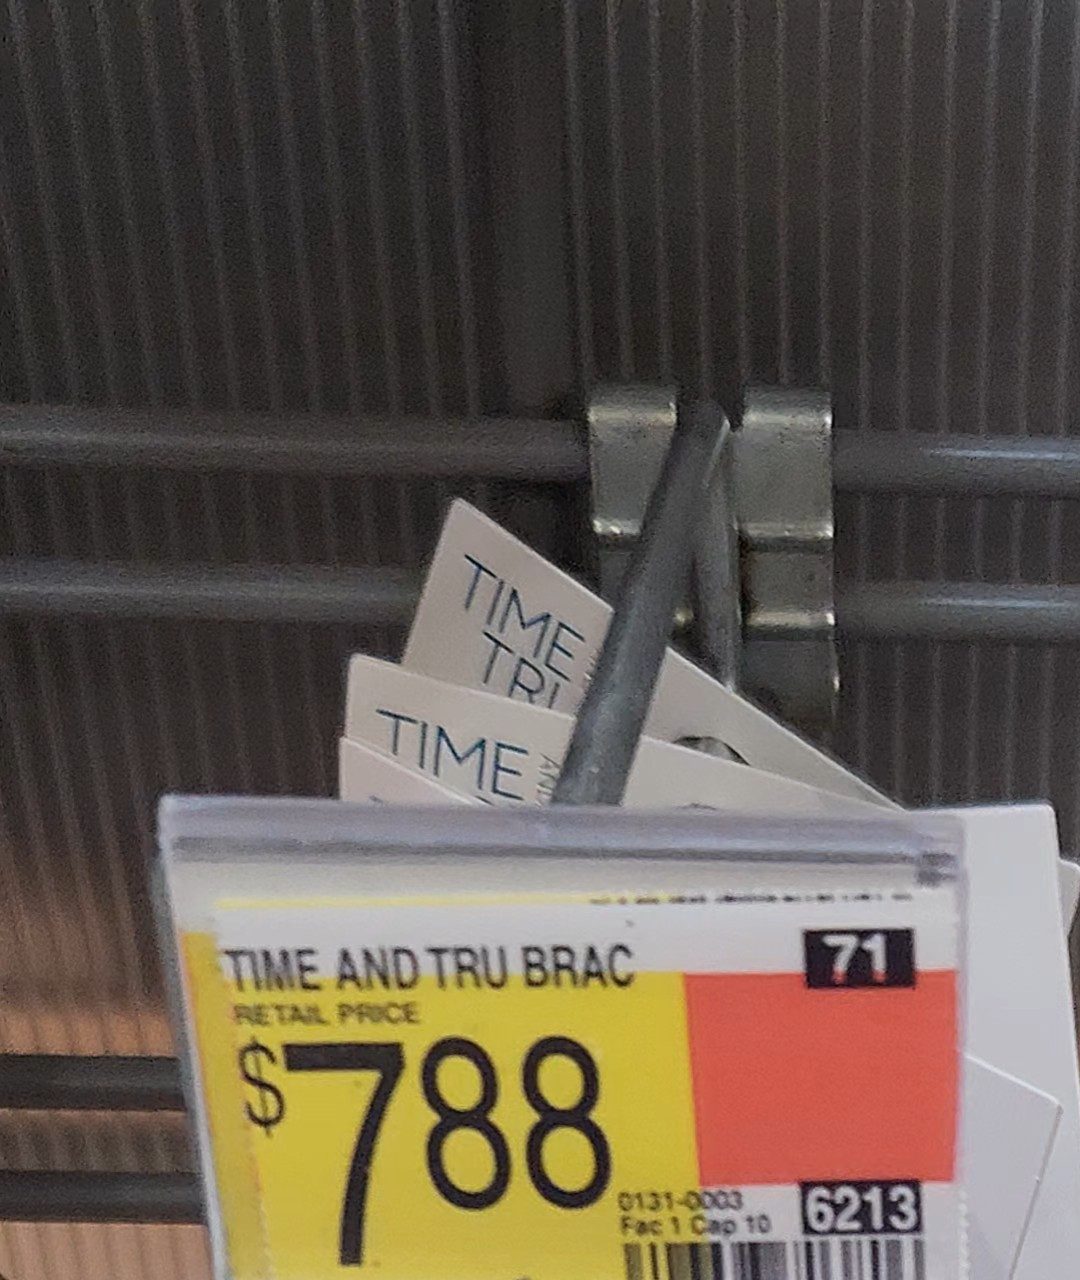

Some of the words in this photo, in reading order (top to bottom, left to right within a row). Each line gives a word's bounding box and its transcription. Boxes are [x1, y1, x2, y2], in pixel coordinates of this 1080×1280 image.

[465, 554, 585, 682] TIME
[376, 709, 529, 800] TIME
[225, 947, 321, 993] TIME
[336, 945, 421, 990] AND
[425, 945, 509, 989] TRU
[522, 943, 635, 988] BRAC
[822, 934, 888, 984] 71
[235, 1003, 327, 1025] RETAIL
[338, 1002, 420, 1024] PRICE
[618, 1191, 742, 1212] 0131-0003
[807, 1187, 917, 1233] 6213
[621, 1216, 663, 1234] Fac
[671, 1216, 680, 1233] 1
[691, 1215, 737, 1238] Cap
[747, 1215, 771, 1233] 10
